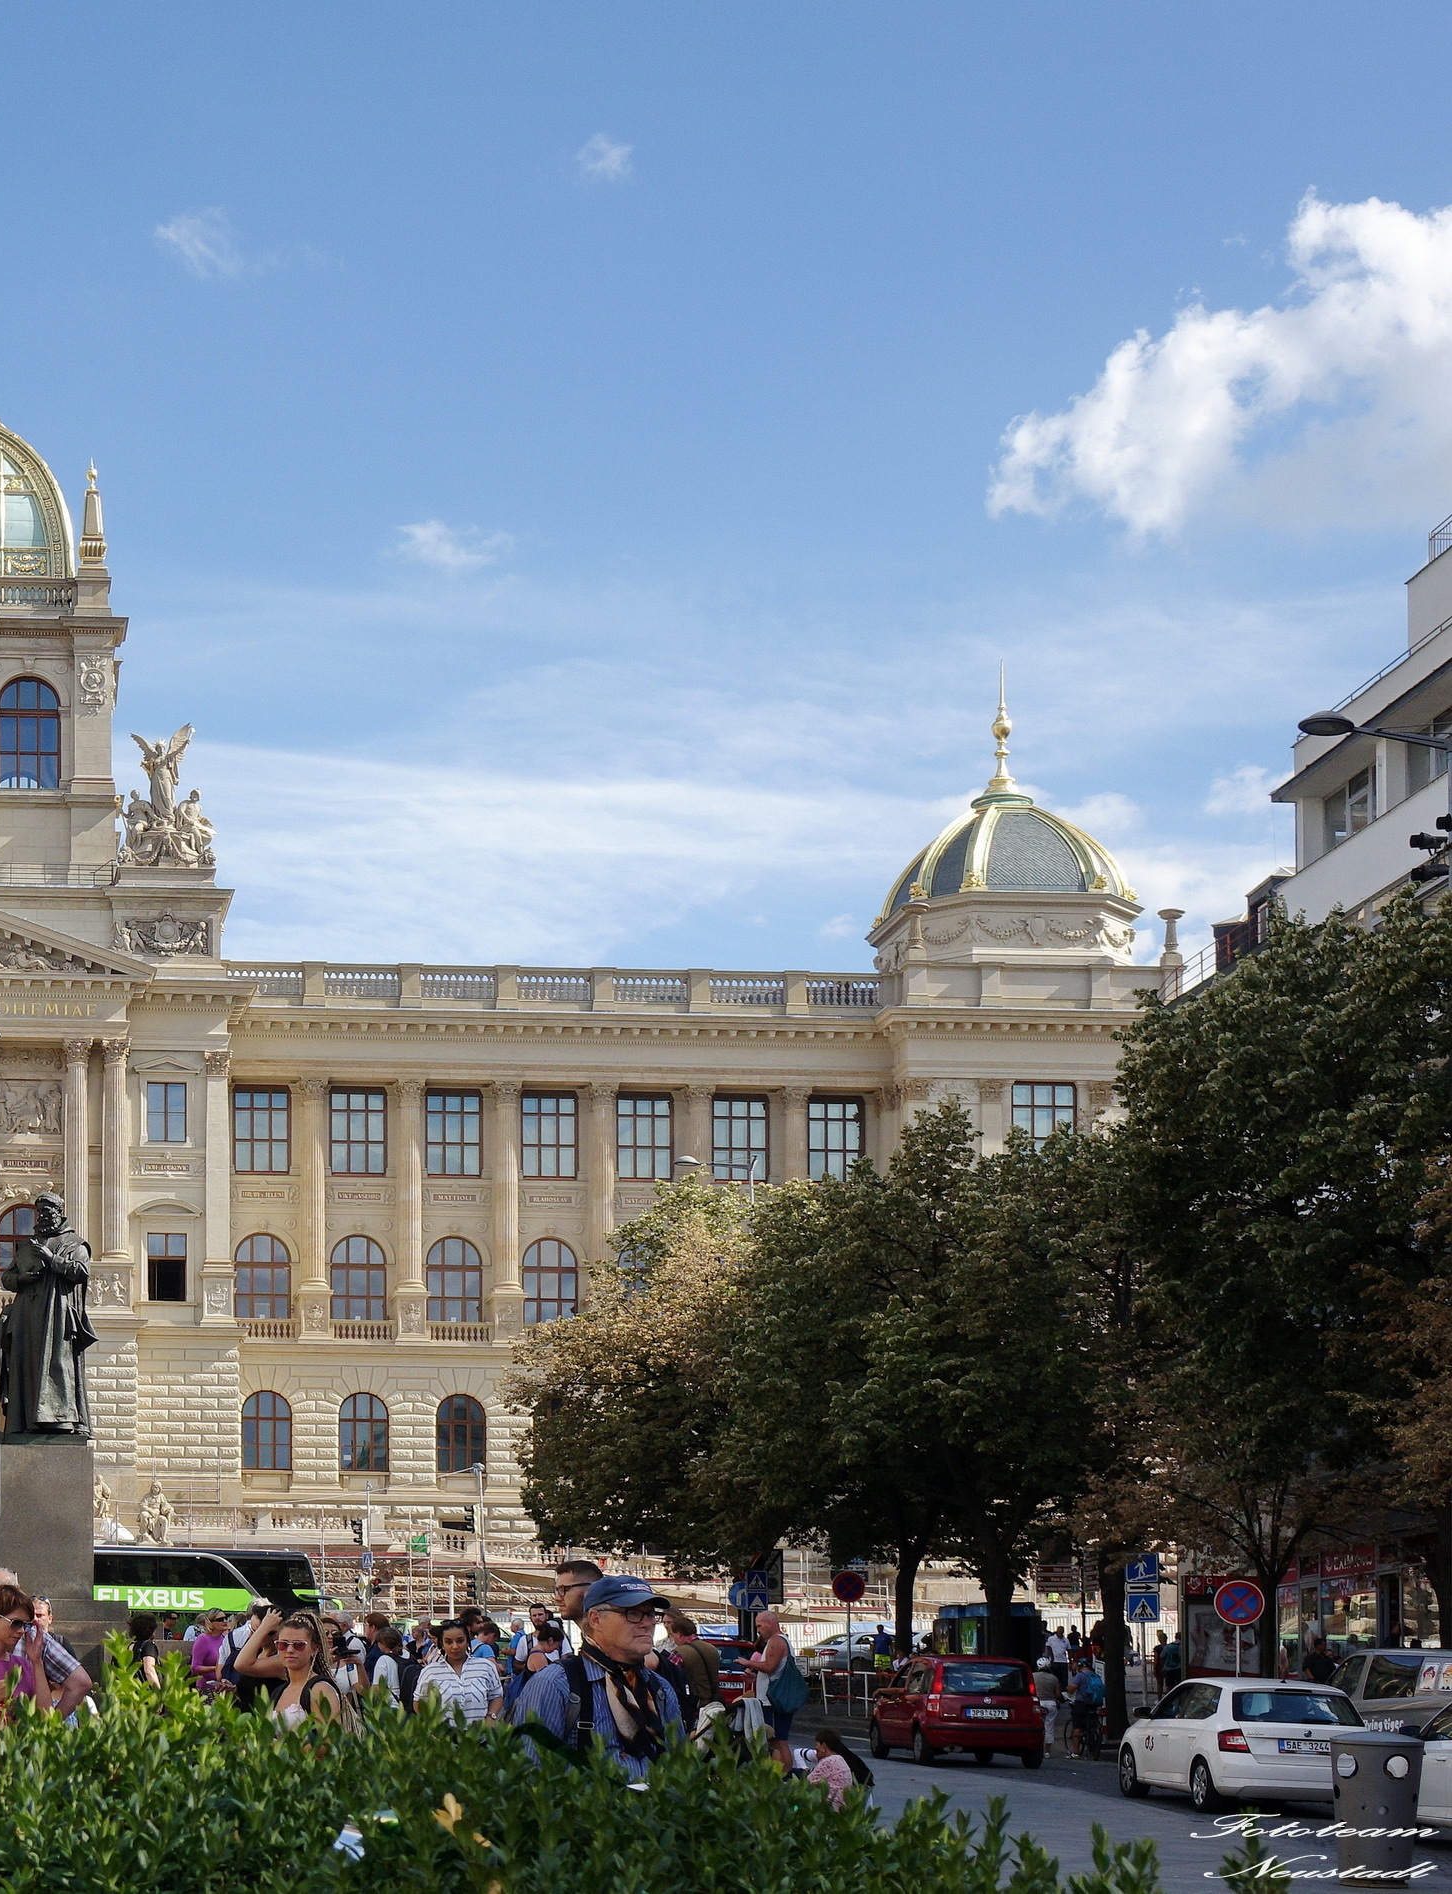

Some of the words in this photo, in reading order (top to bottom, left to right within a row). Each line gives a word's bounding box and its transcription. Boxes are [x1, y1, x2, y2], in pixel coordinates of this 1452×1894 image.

[1206, 1586, 1214, 1595] A
[1286, 1741, 1303, 1750] 5AE
[1308, 1742, 1330, 1751] 3244
